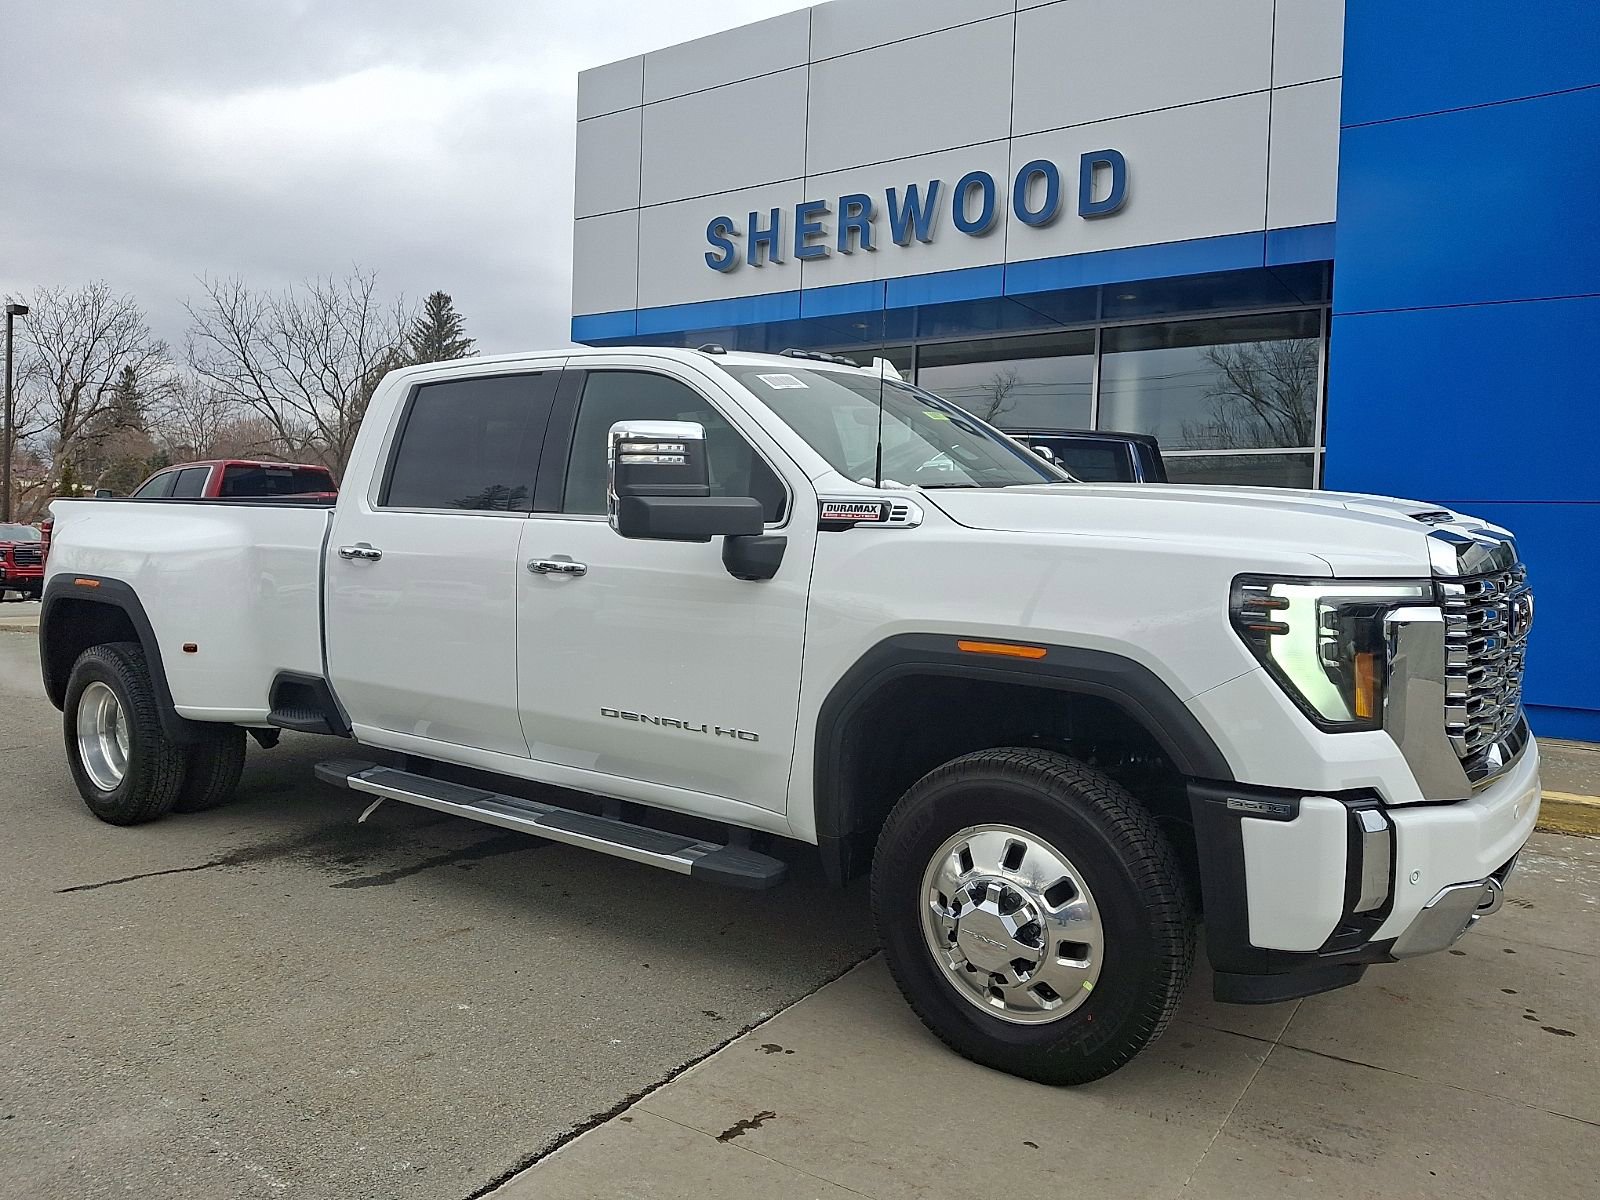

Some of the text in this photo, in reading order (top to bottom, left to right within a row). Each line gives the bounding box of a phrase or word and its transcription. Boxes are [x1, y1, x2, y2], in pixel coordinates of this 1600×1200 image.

[704, 148, 1130, 274] SHERWOOD
[826, 504, 878, 513] DURAMAX
[600, 706, 760, 742] DENALI HD
